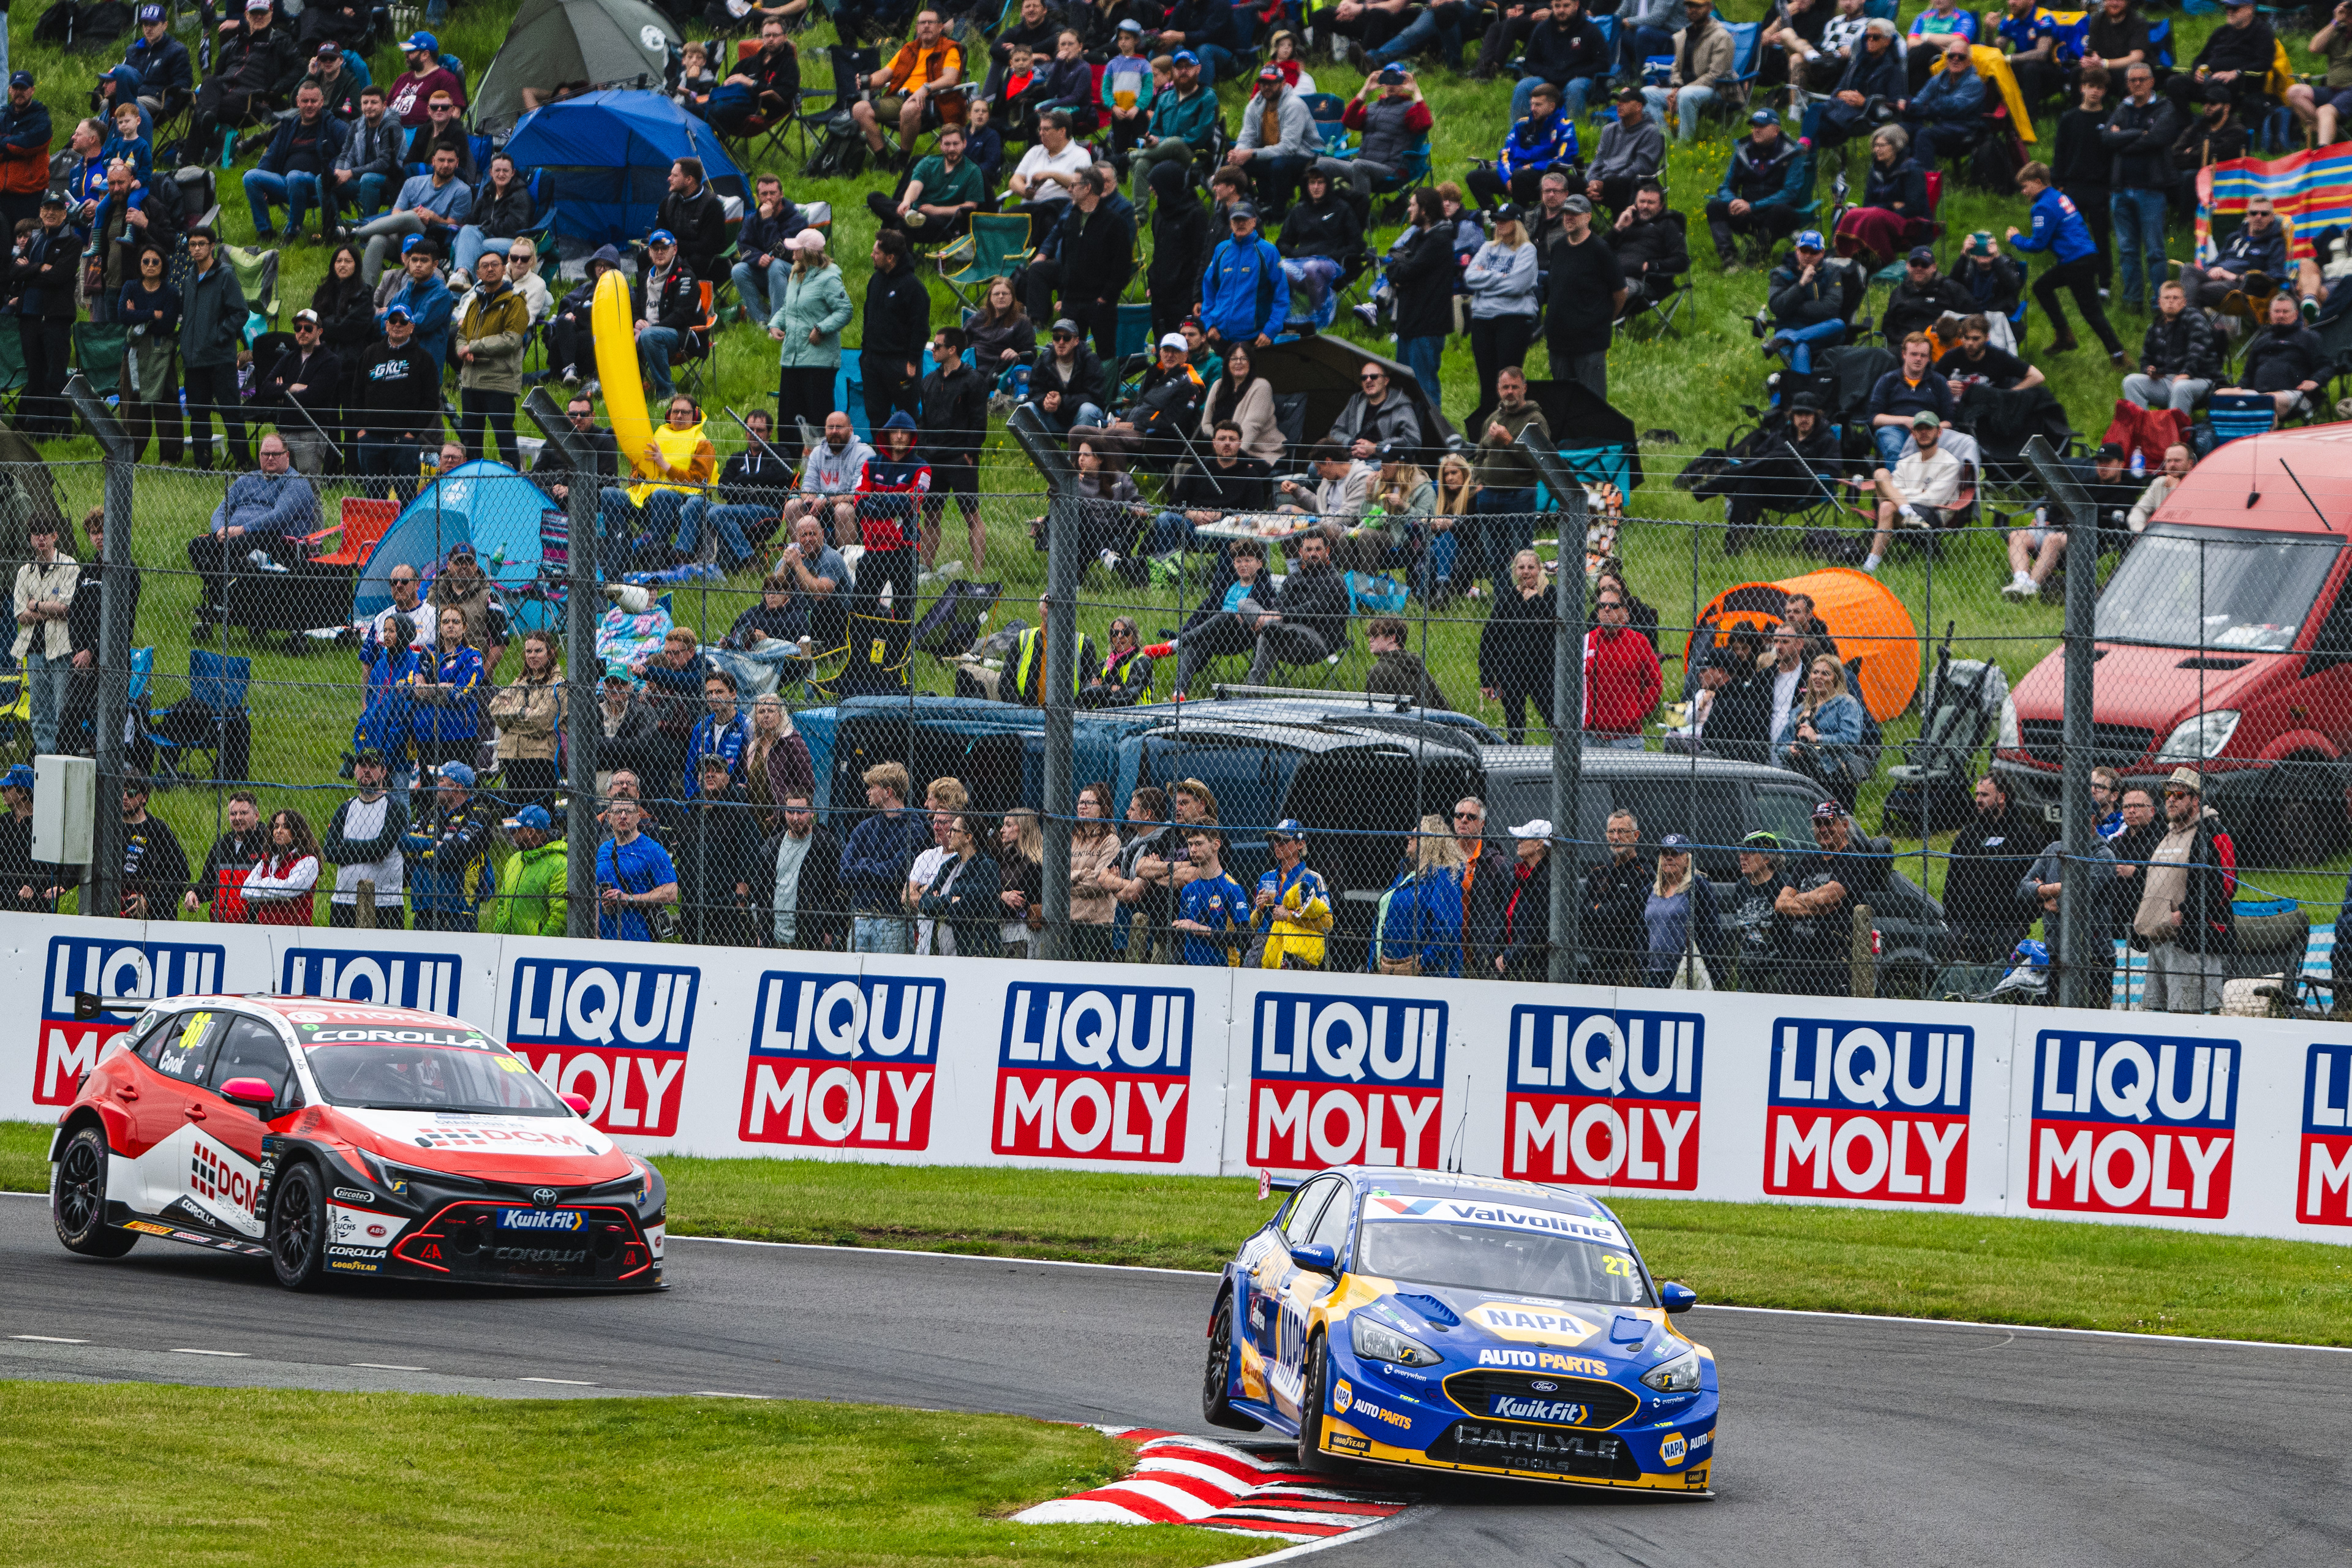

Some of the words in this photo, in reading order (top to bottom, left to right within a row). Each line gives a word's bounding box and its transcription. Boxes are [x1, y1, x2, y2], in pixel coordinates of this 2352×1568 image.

[516, 965, 691, 1046] LIQUI
[179, 1011, 212, 1049] 66
[761, 979, 936, 1060] LIQUI
[1009, 990, 1185, 1070] LIQUI
[311, 1030, 489, 1050] COROLLA
[1262, 1000, 1438, 1082] LIQUI
[158, 1049, 187, 1074] Cook
[493, 1056, 528, 1074] 66
[1517, 1013, 1695, 1096] LIQUI
[1779, 1026, 1964, 1109] LIQUI
[2043, 1038, 2230, 1122] LIQUI
[748, 1064, 933, 1142] MOLY
[1001, 1076, 1186, 1154] MOLY
[478, 1129, 584, 1147] DCM
[1256, 1088, 1440, 1169] MOLY
[1513, 1101, 1698, 1182] MOLY
[1773, 1115, 1967, 1195] MOLY
[2037, 1128, 2231, 1210] MOLY
[337, 1189, 369, 1200] zircotec
[181, 1199, 216, 1227] COROLLA
[217, 1195, 258, 1232] SURFACES
[503, 1210, 575, 1229] KwikFit
[1449, 1204, 1612, 1240] Valvoline
[127, 1221, 170, 1235] AUTOCAR
[334, 1222, 356, 1231] FUCHS
[328, 1246, 387, 1259] COROLLA
[1297, 1246, 1322, 1256] OSRAM
[331, 1261, 377, 1272] GOODYEAR
[1602, 1254, 1630, 1277] 27
[1487, 1310, 1582, 1334] NAPA
[1394, 1368, 1427, 1382] everywhen
[1479, 1349, 1536, 1366] AUTO
[1539, 1352, 1608, 1376] PARTS
[1335, 1386, 1349, 1406] NAPA
[1534, 1381, 1553, 1391] Ford
[1495, 1396, 1578, 1422] KwikFit
[1662, 1395, 1685, 1405] everywhen
[1353, 1398, 1379, 1418] AUTO
[1378, 1408, 1412, 1430] PARTS
[1333, 1436, 1366, 1449] GOODYEAR
[1664, 1441, 1684, 1458] NAPA
[1689, 1433, 1708, 1450] AUTO
